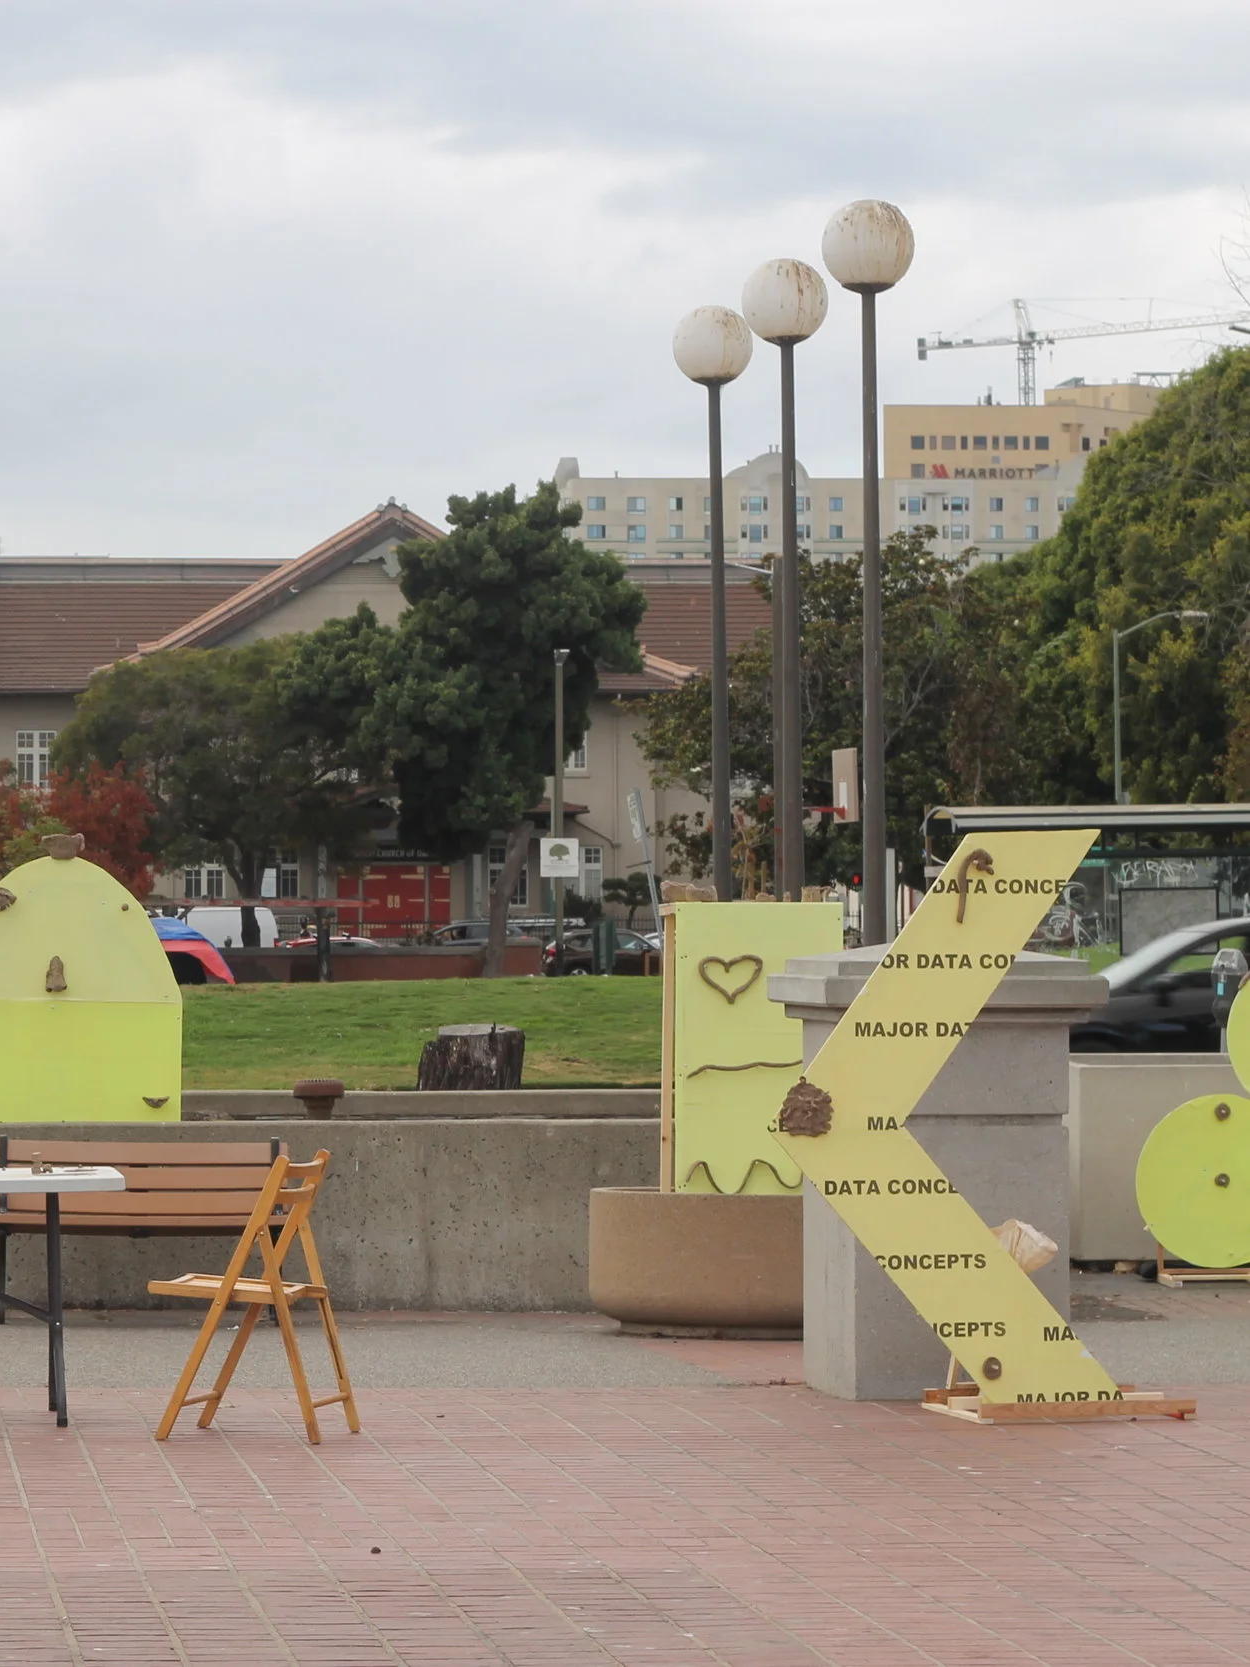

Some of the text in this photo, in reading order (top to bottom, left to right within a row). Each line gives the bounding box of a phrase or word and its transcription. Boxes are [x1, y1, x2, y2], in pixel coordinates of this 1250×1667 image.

[954, 468, 1035, 479] MARRIOTT
[880, 954, 909, 969] OR
[917, 954, 973, 969] DATA
[855, 1022, 928, 1037] MAJOR
[824, 1180, 881, 1195] DATA
[874, 1254, 986, 1270] CONCEPTS
[1043, 1325, 1082, 1342] MA
